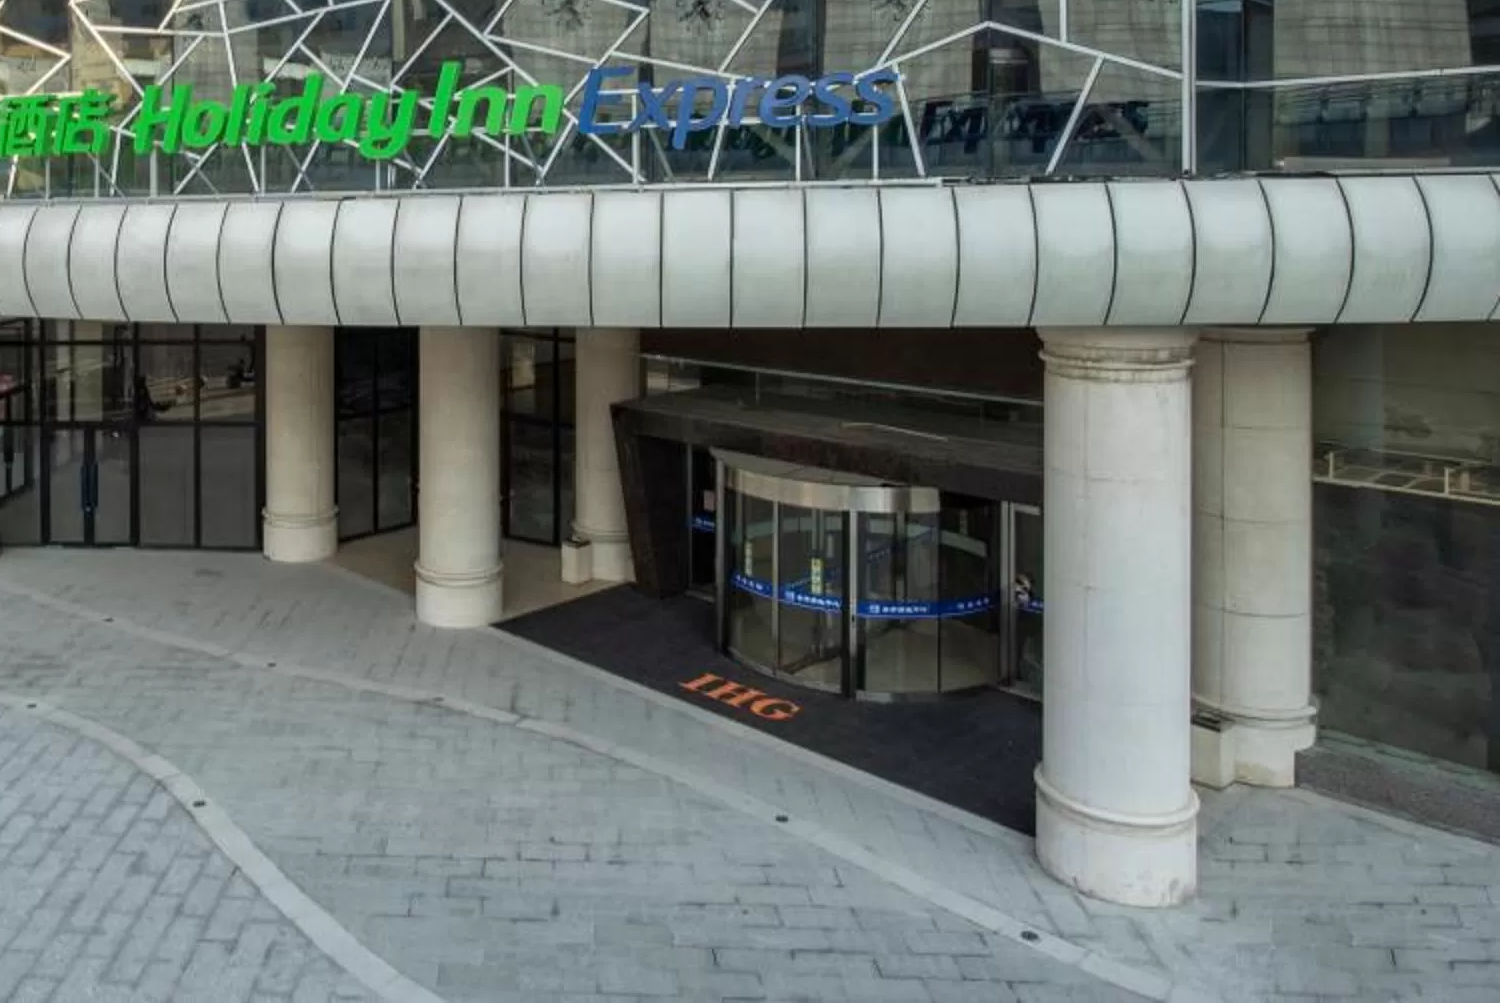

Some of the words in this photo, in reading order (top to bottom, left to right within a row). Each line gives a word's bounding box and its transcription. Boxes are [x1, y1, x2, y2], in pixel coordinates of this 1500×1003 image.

[133, 71, 419, 159] Holiday
[431, 61, 563, 138] Inn
[578, 66, 899, 150] Express
[678, 673, 802, 720] IHG
